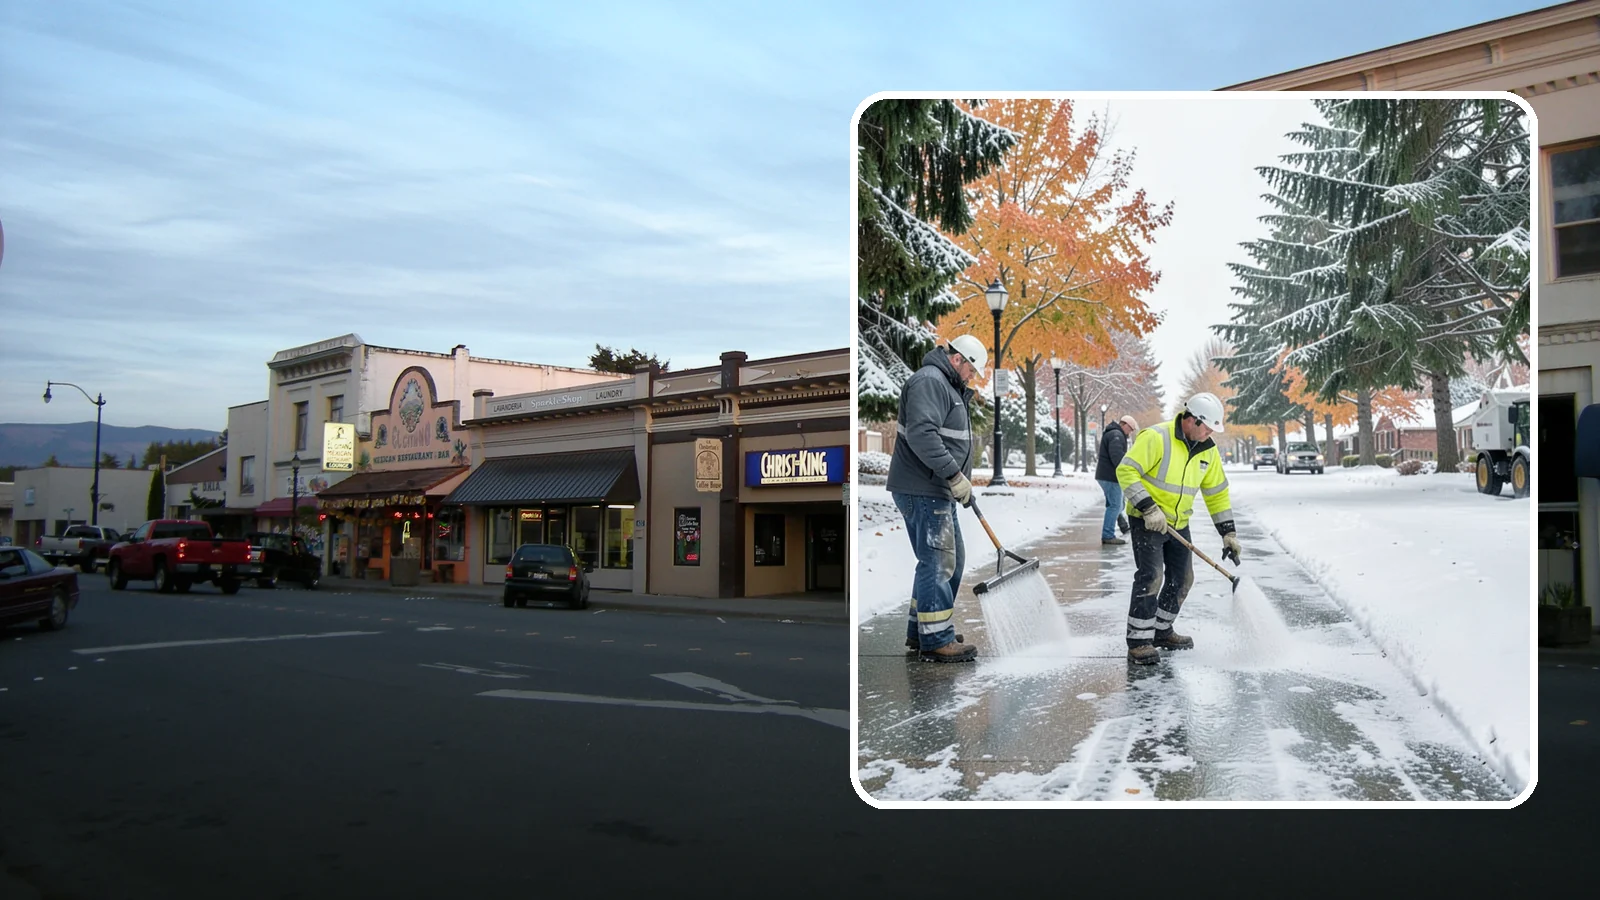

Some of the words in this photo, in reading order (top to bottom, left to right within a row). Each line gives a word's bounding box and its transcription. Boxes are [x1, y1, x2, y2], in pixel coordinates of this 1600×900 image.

[493, 402, 523, 412] LAVANDERIA
[562, 394, 582, 404] Shop
[595, 389, 623, 400] LAUNDRY
[373, 455, 396, 464] MEXICAN
[397, 451, 434, 462] RESTAURANT
[438, 450, 450, 459] BAR
[760, 451, 797, 478] CHRIST
[799, 449, 827, 476] KING
